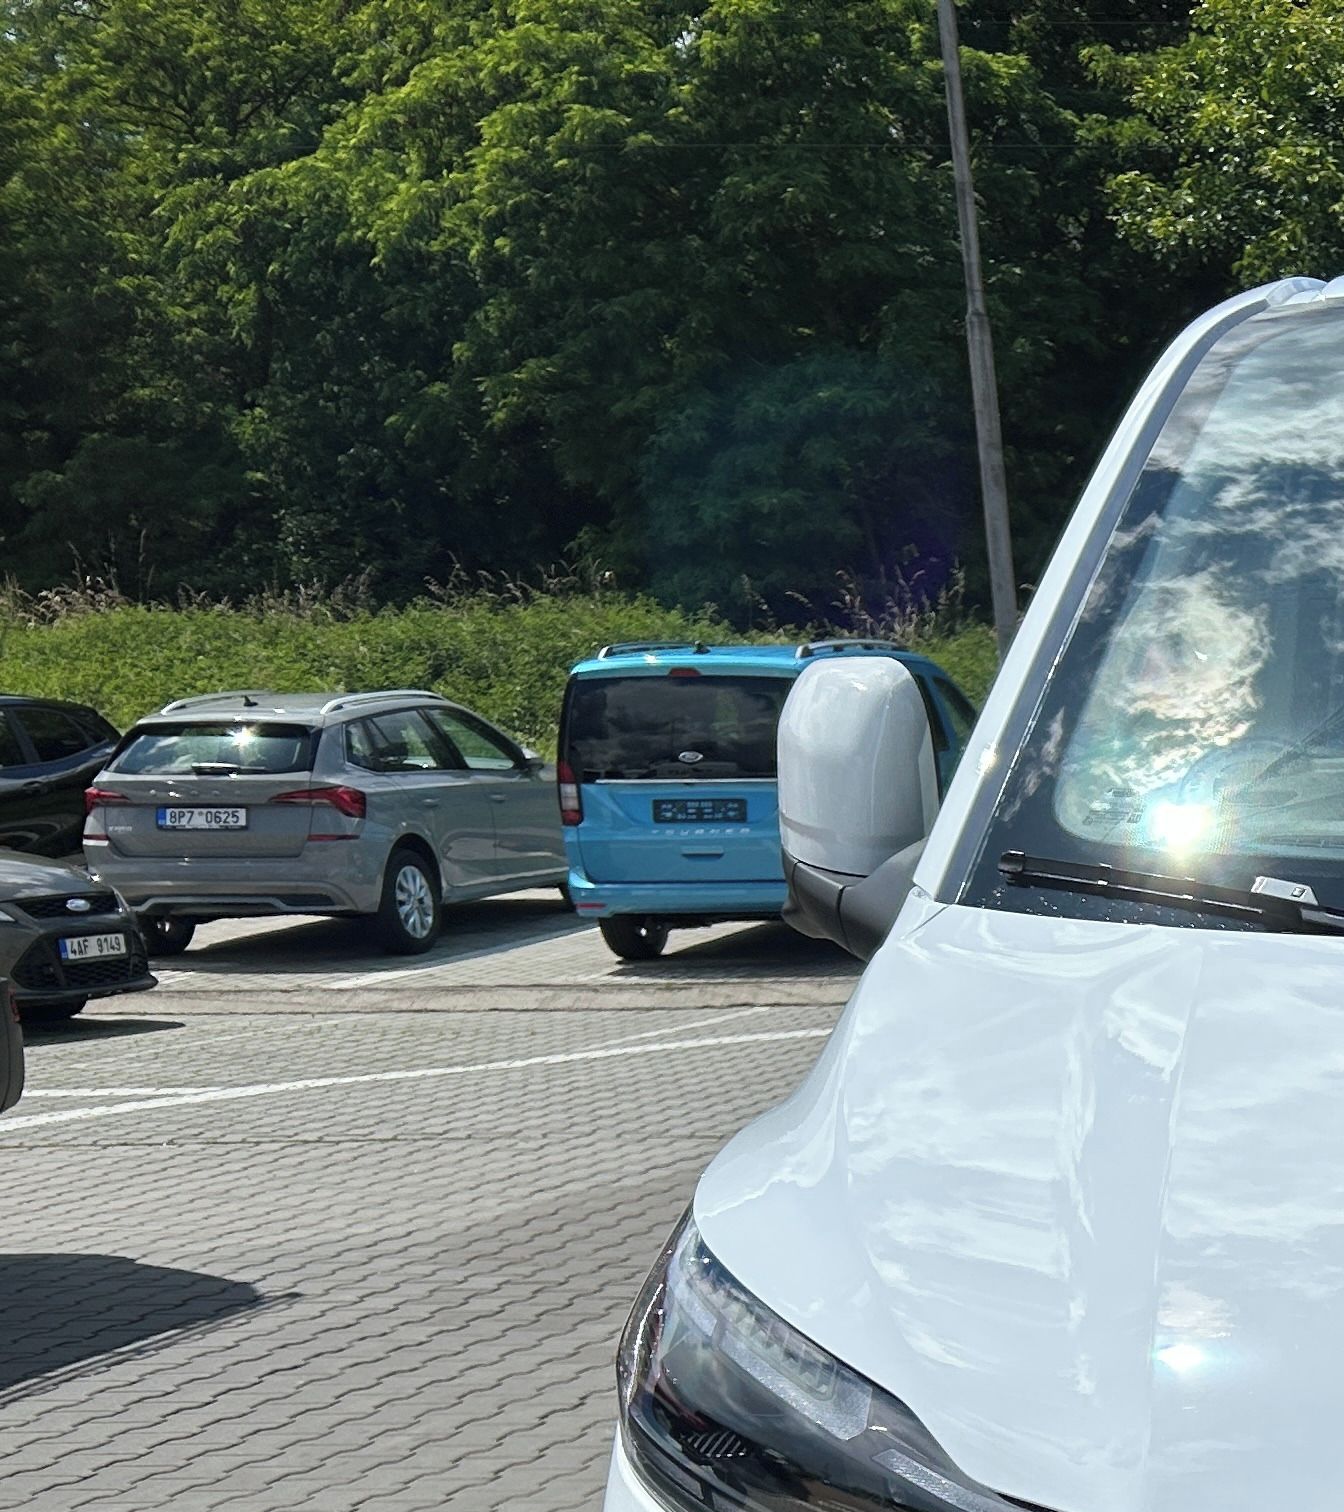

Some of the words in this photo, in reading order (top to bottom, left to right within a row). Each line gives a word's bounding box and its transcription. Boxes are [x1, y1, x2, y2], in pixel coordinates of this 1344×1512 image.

[169, 810, 195, 825] 8P7
[205, 809, 240, 824] 0625
[70, 938, 89, 956] 4AF
[97, 936, 121, 954] 9149
